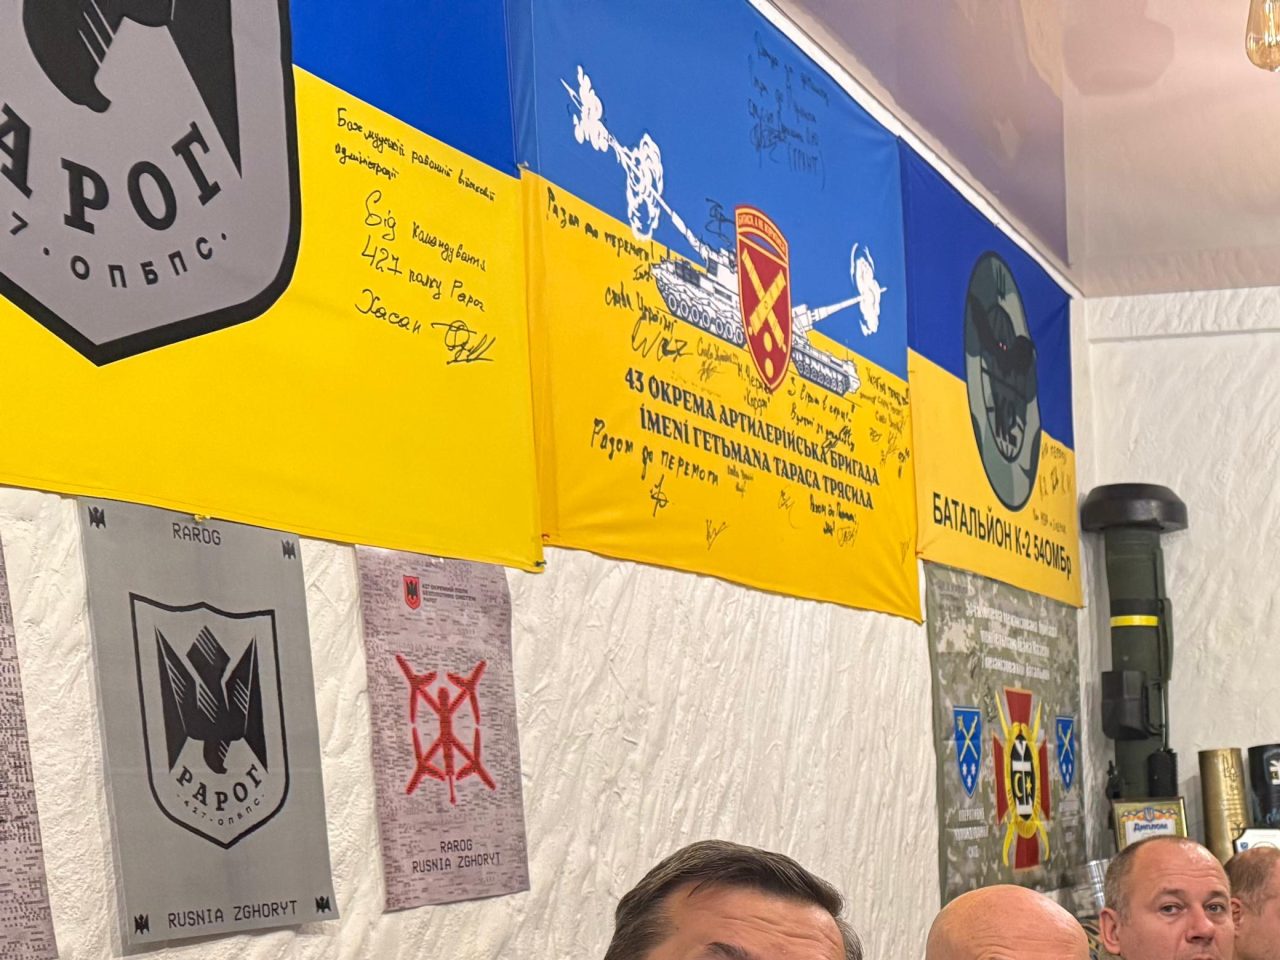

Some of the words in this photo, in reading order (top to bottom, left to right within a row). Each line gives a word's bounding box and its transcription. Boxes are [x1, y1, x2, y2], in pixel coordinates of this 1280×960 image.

[70, 236, 213, 289] ОПБПС
[361, 235, 403, 276] 427
[625, 367, 645, 393] 43
[649, 375, 716, 421] ОКРЕМА
[719, 404, 829, 465] АРТИЛЕРІЙСЬКА
[830, 450, 880, 486] БРИГАДА
[773, 455, 822, 491] ТАРАСА
[822, 473, 874, 510] ТРЯСИЛА
[172, 522, 221, 546] RAROG
[933, 491, 1012, 550] БАТАЛЬЙОН
[1015, 526, 1031, 558] К-2
[176, 763, 262, 811] РАРОГ
[412, 858, 451, 874] RUSNIA
[458, 852, 500, 868] ZGHORYT
[440, 839, 472, 853] RAROG
[168, 908, 224, 928] RUSNIA
[233, 900, 297, 921] ZGHORYT
